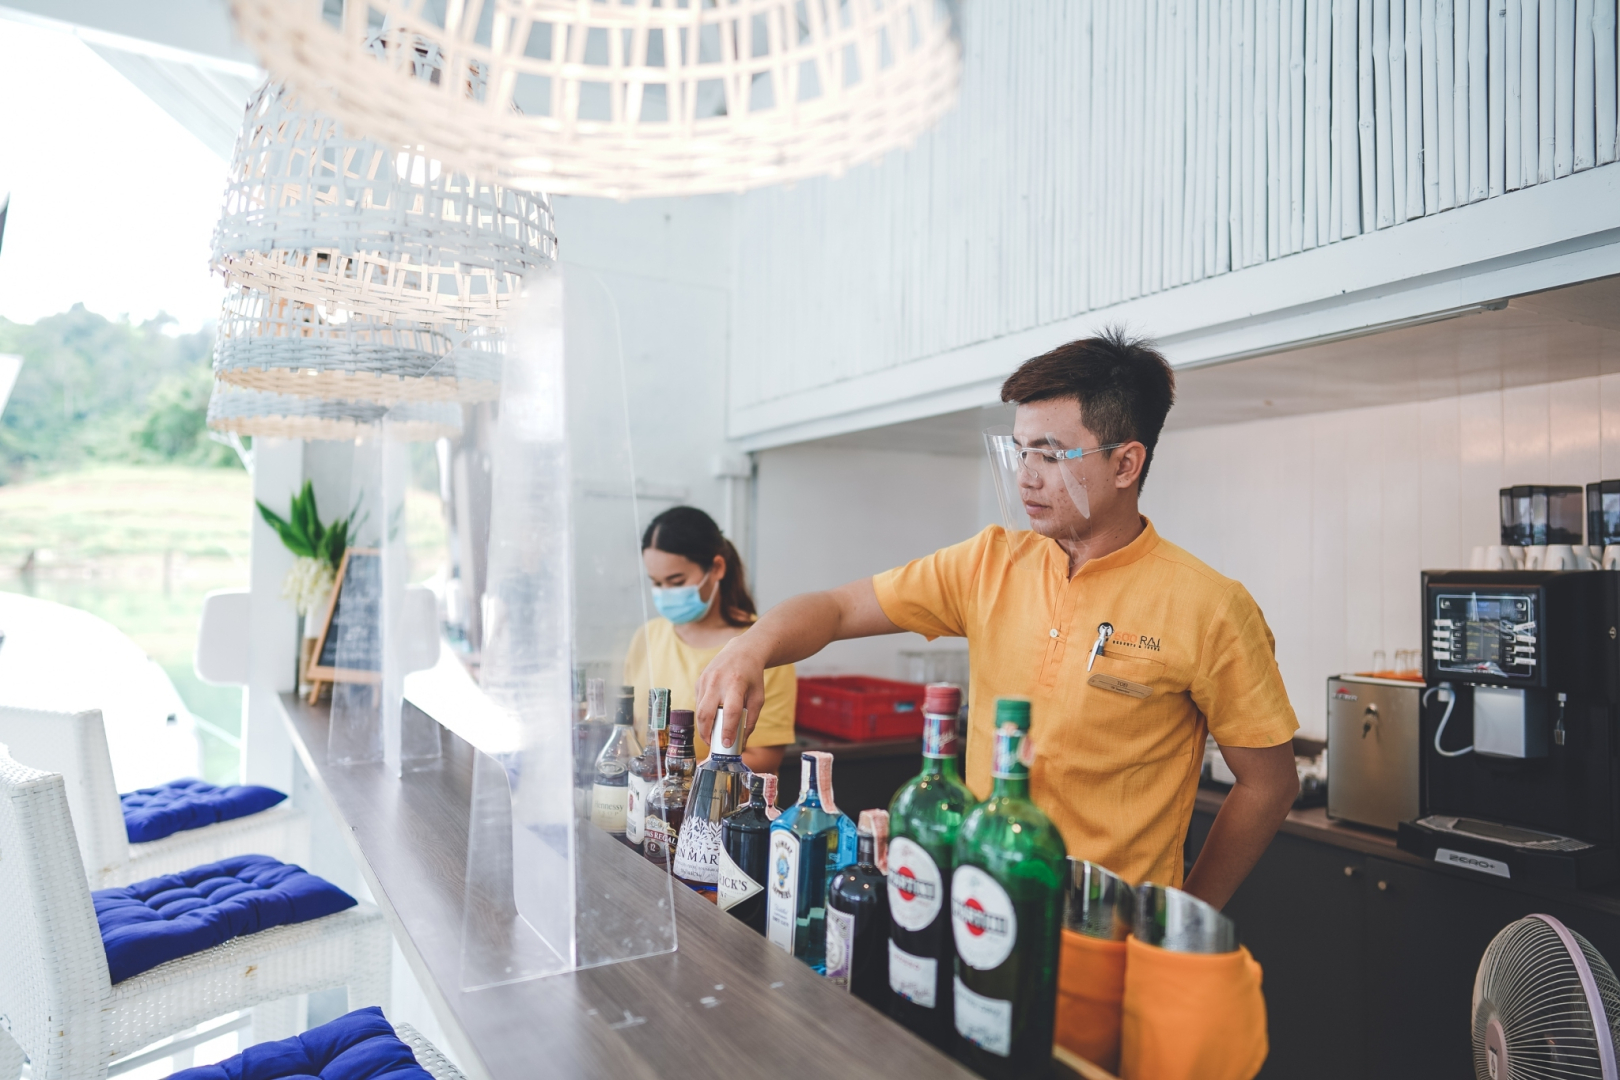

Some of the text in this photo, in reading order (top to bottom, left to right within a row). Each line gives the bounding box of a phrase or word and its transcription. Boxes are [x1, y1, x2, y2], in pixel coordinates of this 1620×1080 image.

[1140, 635, 1160, 647] RAI
[594, 801, 625, 813] Hennessy
[654, 832, 677, 846] REGAL
[650, 843, 656, 852] 12
[687, 852, 719, 866] MAR
